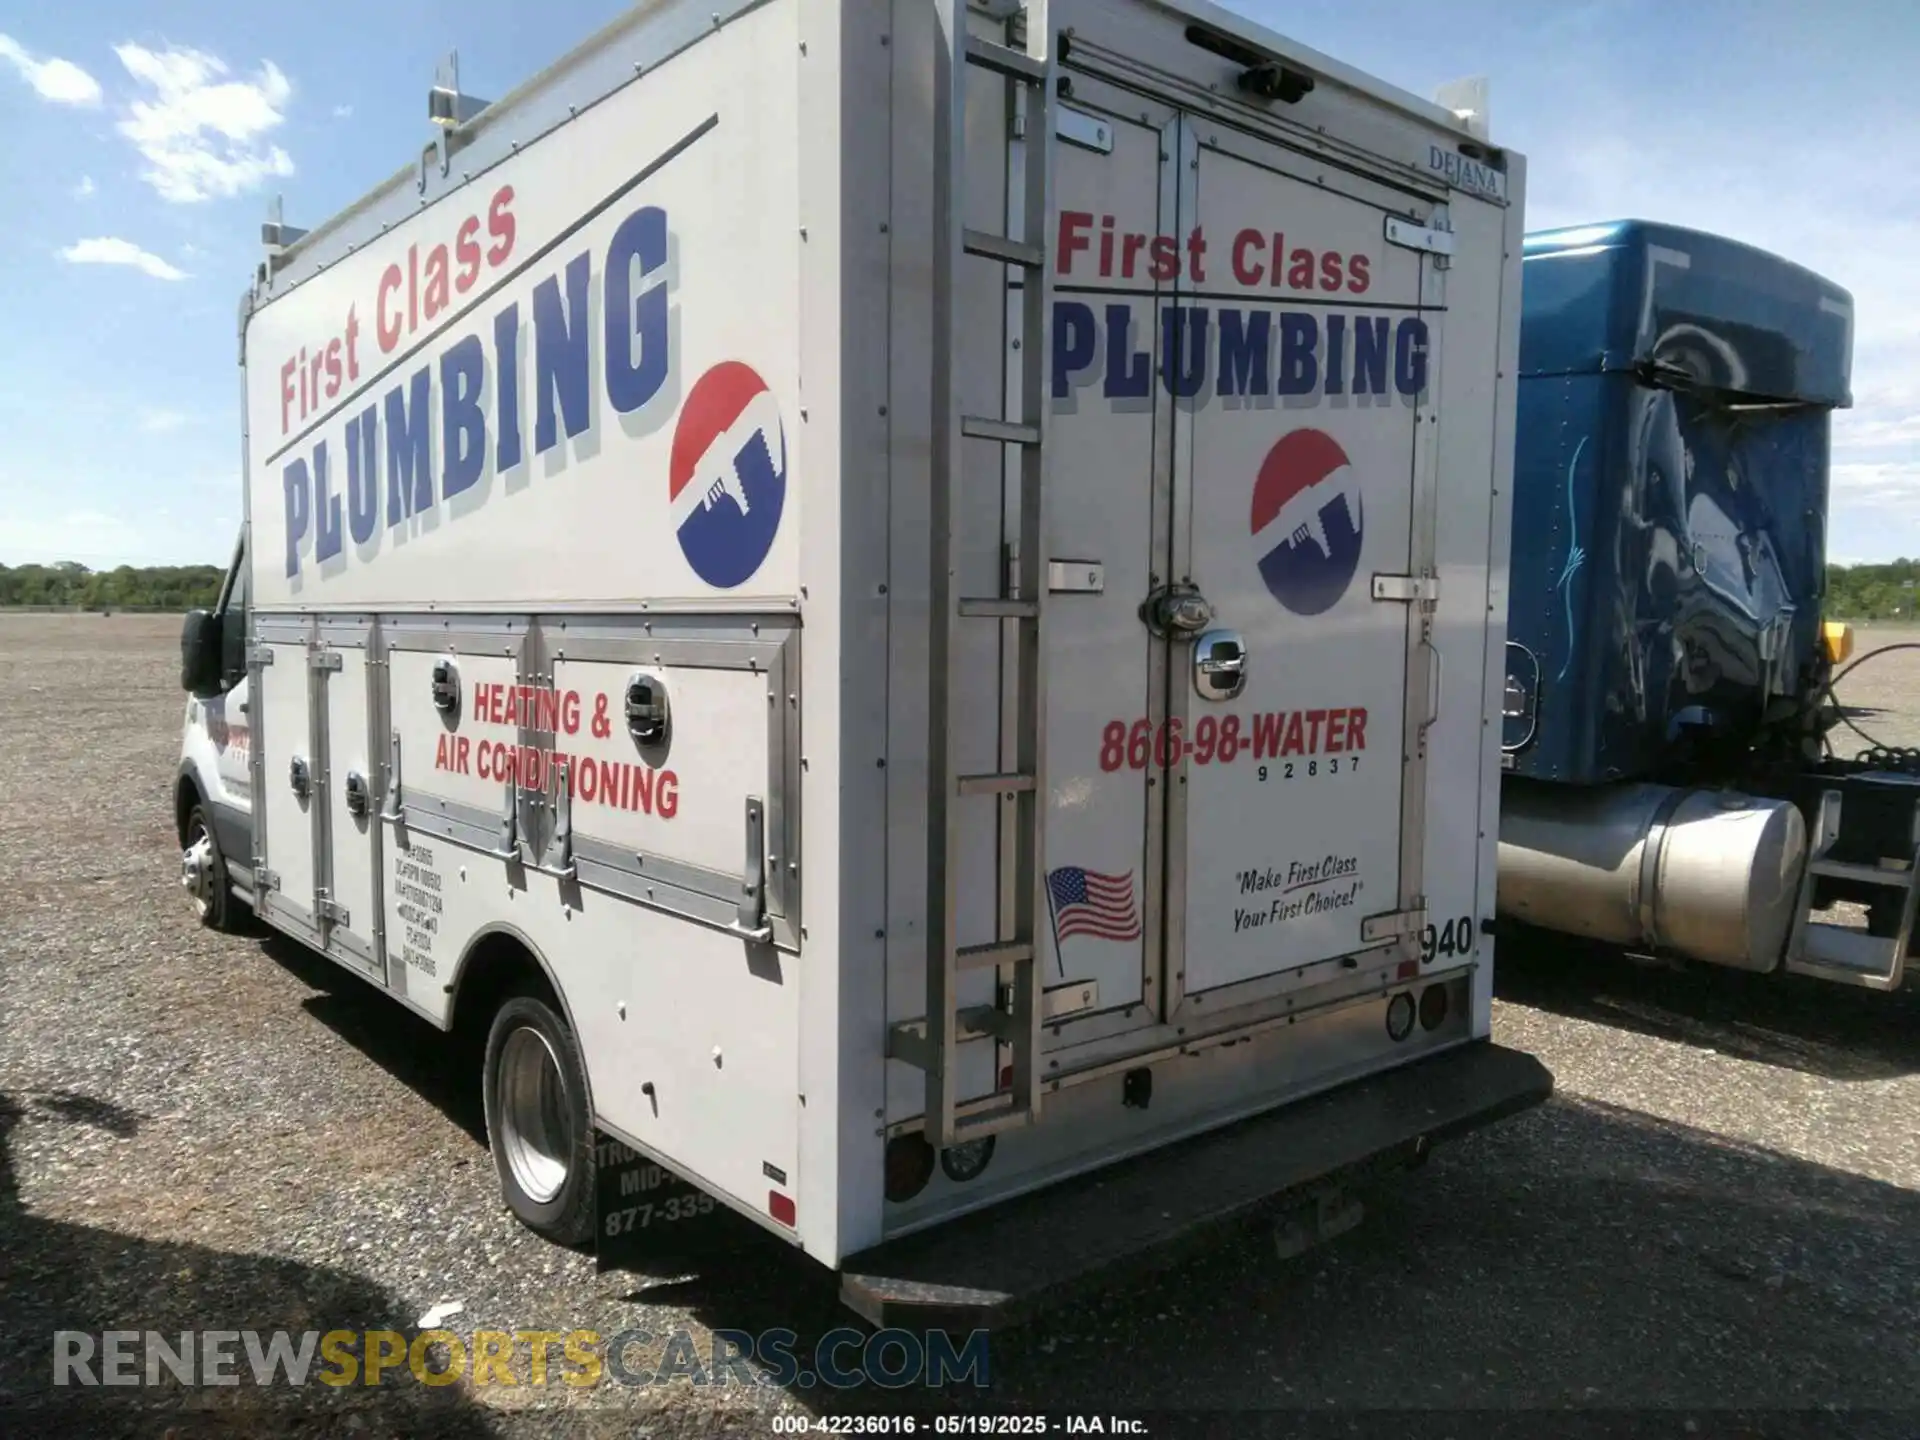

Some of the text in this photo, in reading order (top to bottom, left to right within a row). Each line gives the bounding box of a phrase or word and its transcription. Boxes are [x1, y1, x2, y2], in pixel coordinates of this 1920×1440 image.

[1429, 146, 1498, 195] DEJANA
[1056, 211, 1371, 294] First Class
[281, 185, 517, 434] First Class
[1052, 302, 1430, 398] PLUMBING
[283, 206, 672, 578] PLUMBING
[474, 683, 611, 738] HEATING &
[1100, 707, 1368, 772] 866-98-WATER
[435, 733, 678, 818] AIR CONDITIONING
[1287, 860, 1319, 885] First
[1322, 855, 1357, 877] Class
[1233, 910, 1267, 933] Your
[1269, 901, 1302, 922] First
[1421, 916, 1473, 963] 940
